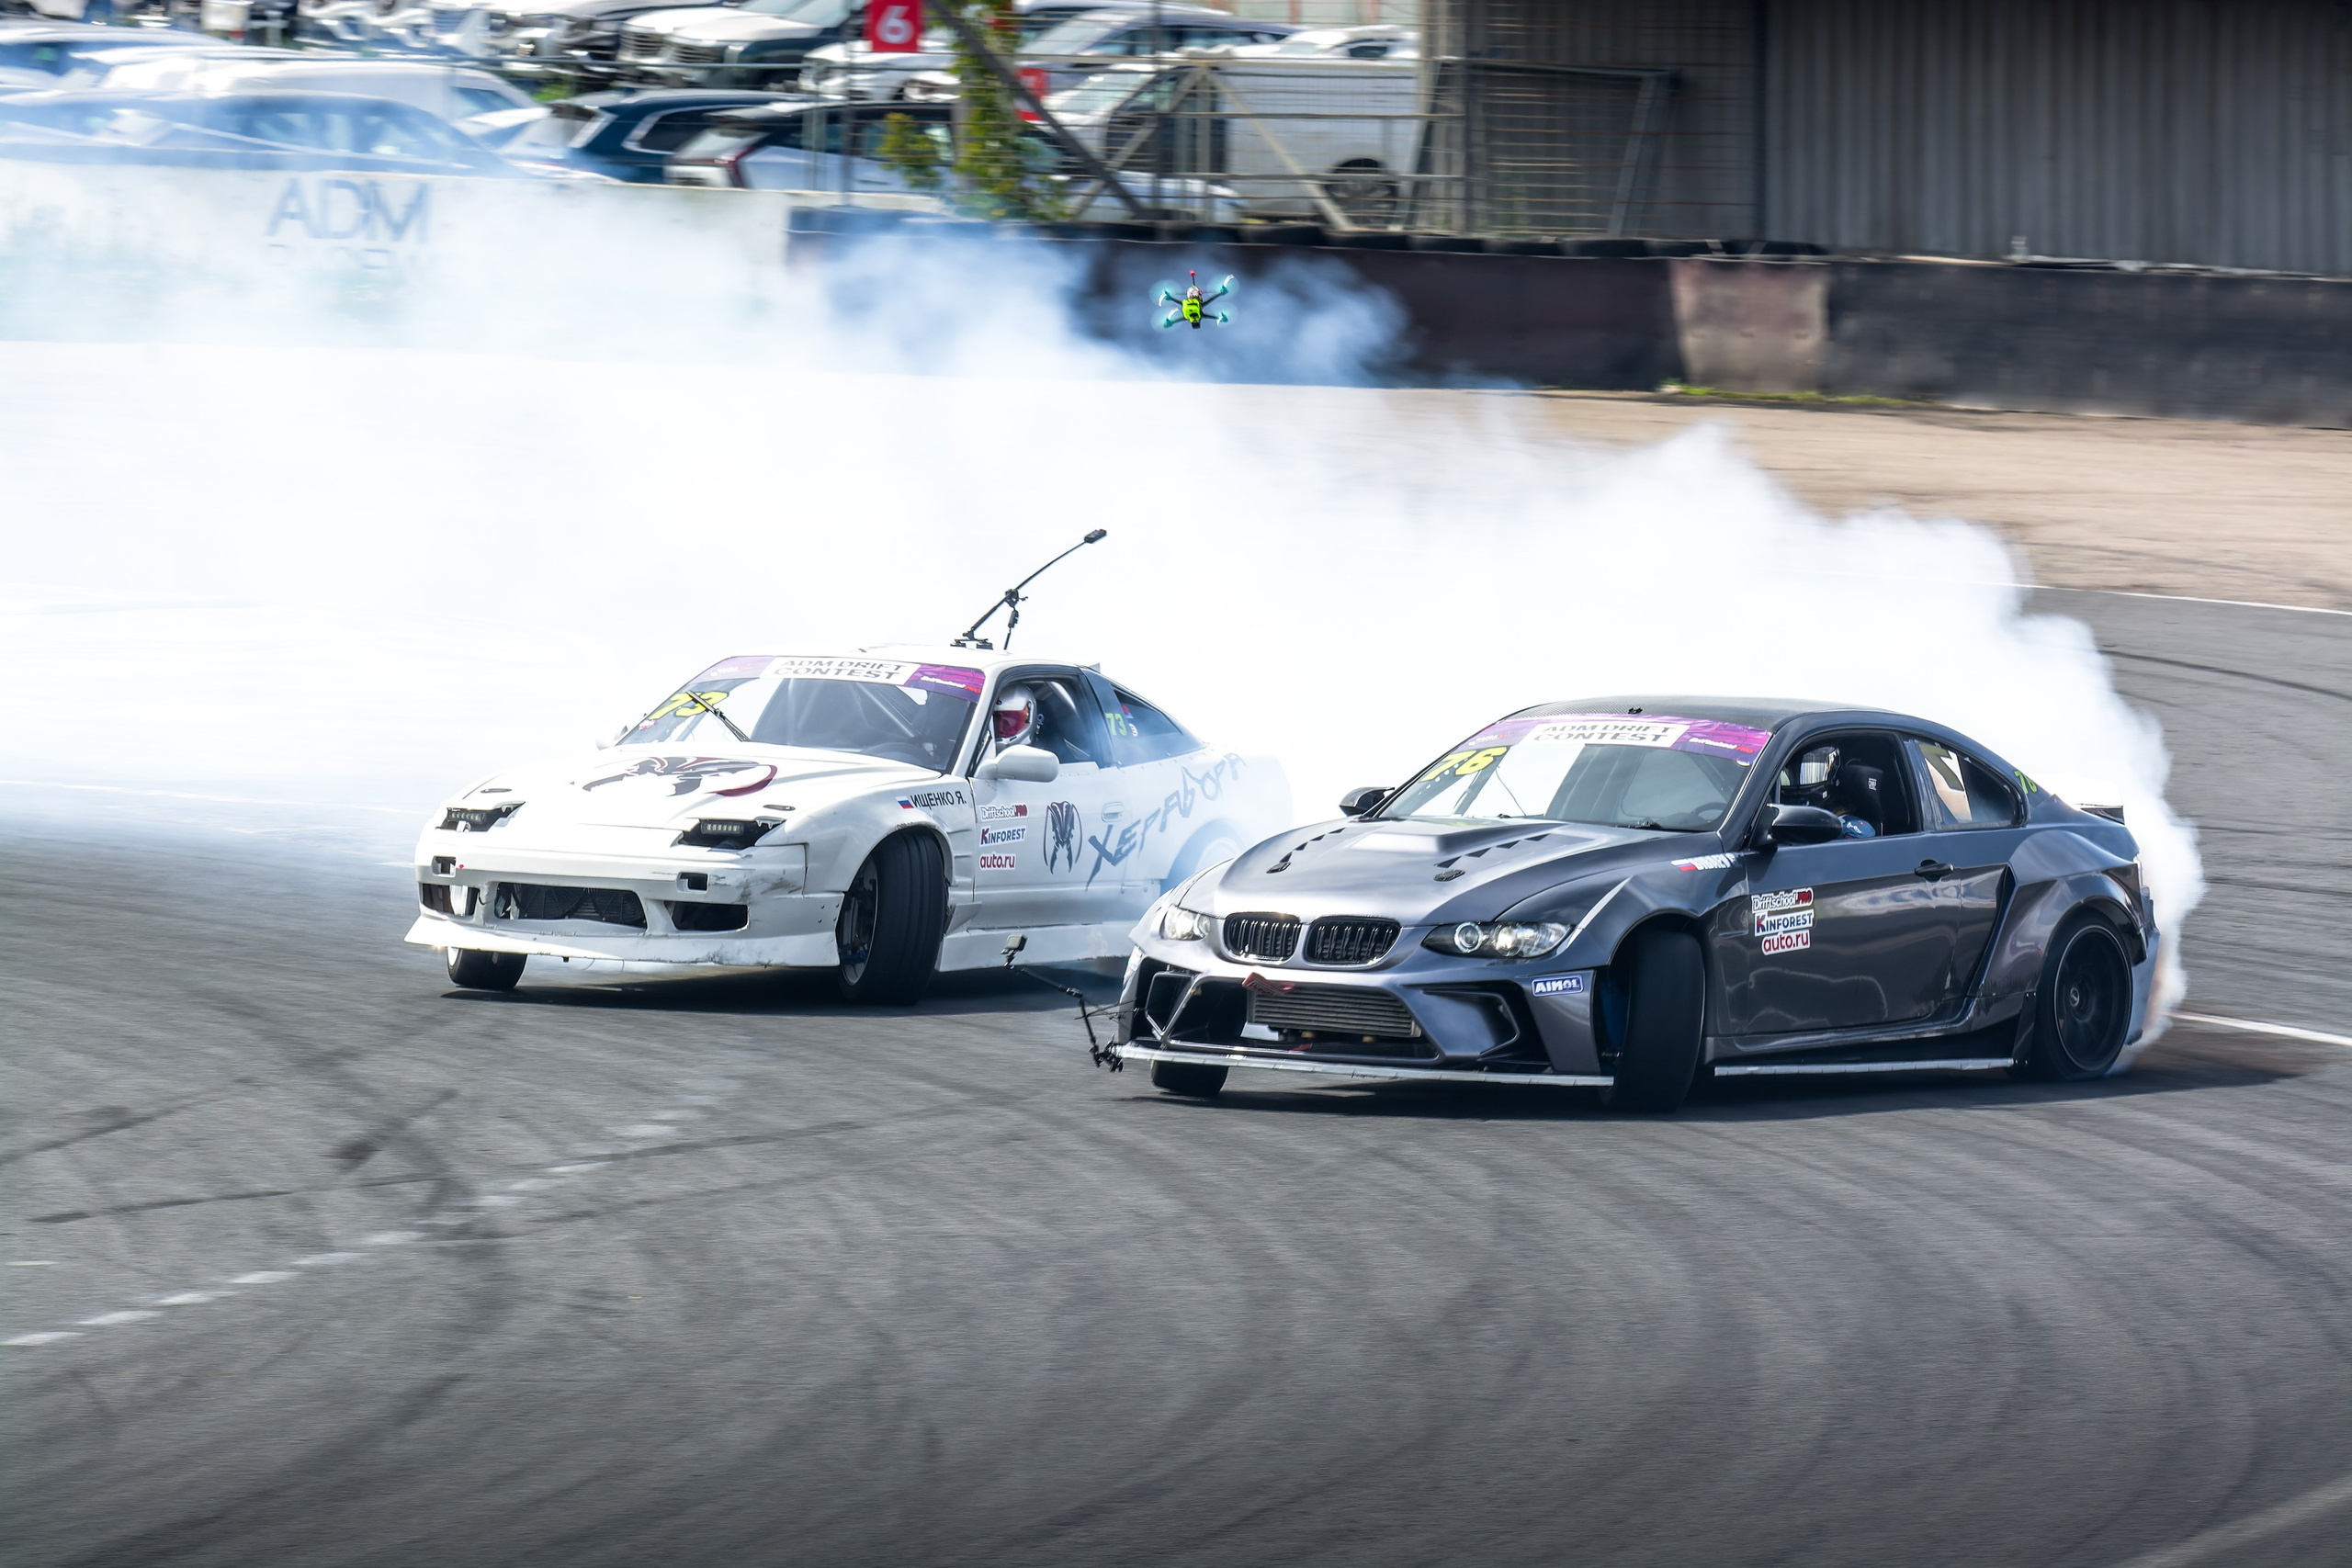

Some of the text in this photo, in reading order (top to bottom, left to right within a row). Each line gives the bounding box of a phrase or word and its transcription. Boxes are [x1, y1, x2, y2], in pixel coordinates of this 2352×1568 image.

[875, 5, 915, 44] 6
[266, 178, 430, 243] ADM
[774, 667, 899, 681] CONTEST
[783, 660, 907, 671] ADM DRIFT
[647, 690, 730, 722] 73
[1104, 713, 1127, 736] 73
[1541, 724, 1676, 734] ADM DRIFT
[1533, 732, 1668, 743] CONTEST
[1419, 745, 1509, 783] 76
[2014, 770, 2038, 795] 76
[910, 790, 967, 810] ИЩЕНКО Я.
[980, 853, 1015, 869] auto.ru
[1763, 931, 1809, 953] auto.ru
